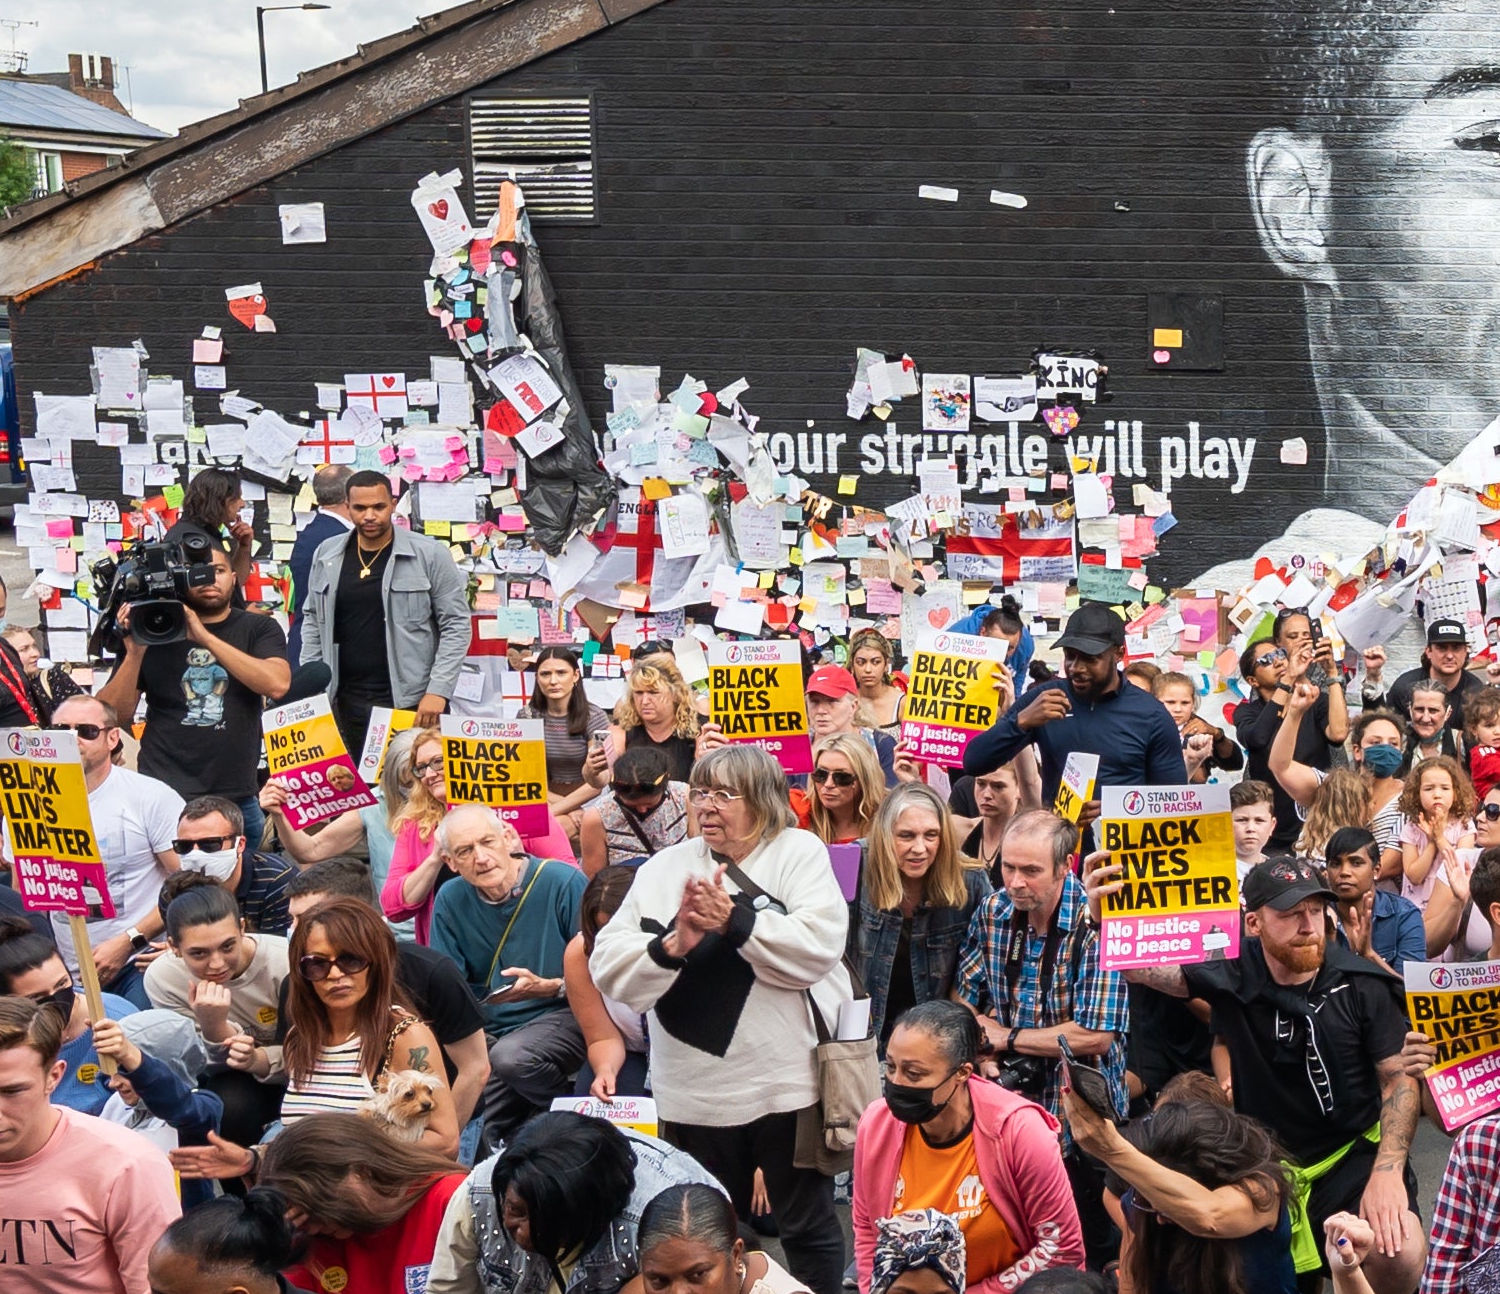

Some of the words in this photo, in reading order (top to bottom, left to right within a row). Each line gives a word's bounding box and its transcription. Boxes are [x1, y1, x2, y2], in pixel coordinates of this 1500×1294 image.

[1037, 358, 1099, 388] KING
[1065, 421, 1147, 478] will
[1161, 421, 1257, 494] play
[270, 734, 287, 751] No
[291, 729, 305, 744] to
[273, 745, 324, 769] racism
[275, 775, 301, 791] No
[301, 771, 323, 786] to
[287, 785, 334, 809] Boris
[296, 793, 371, 824] Johnson
